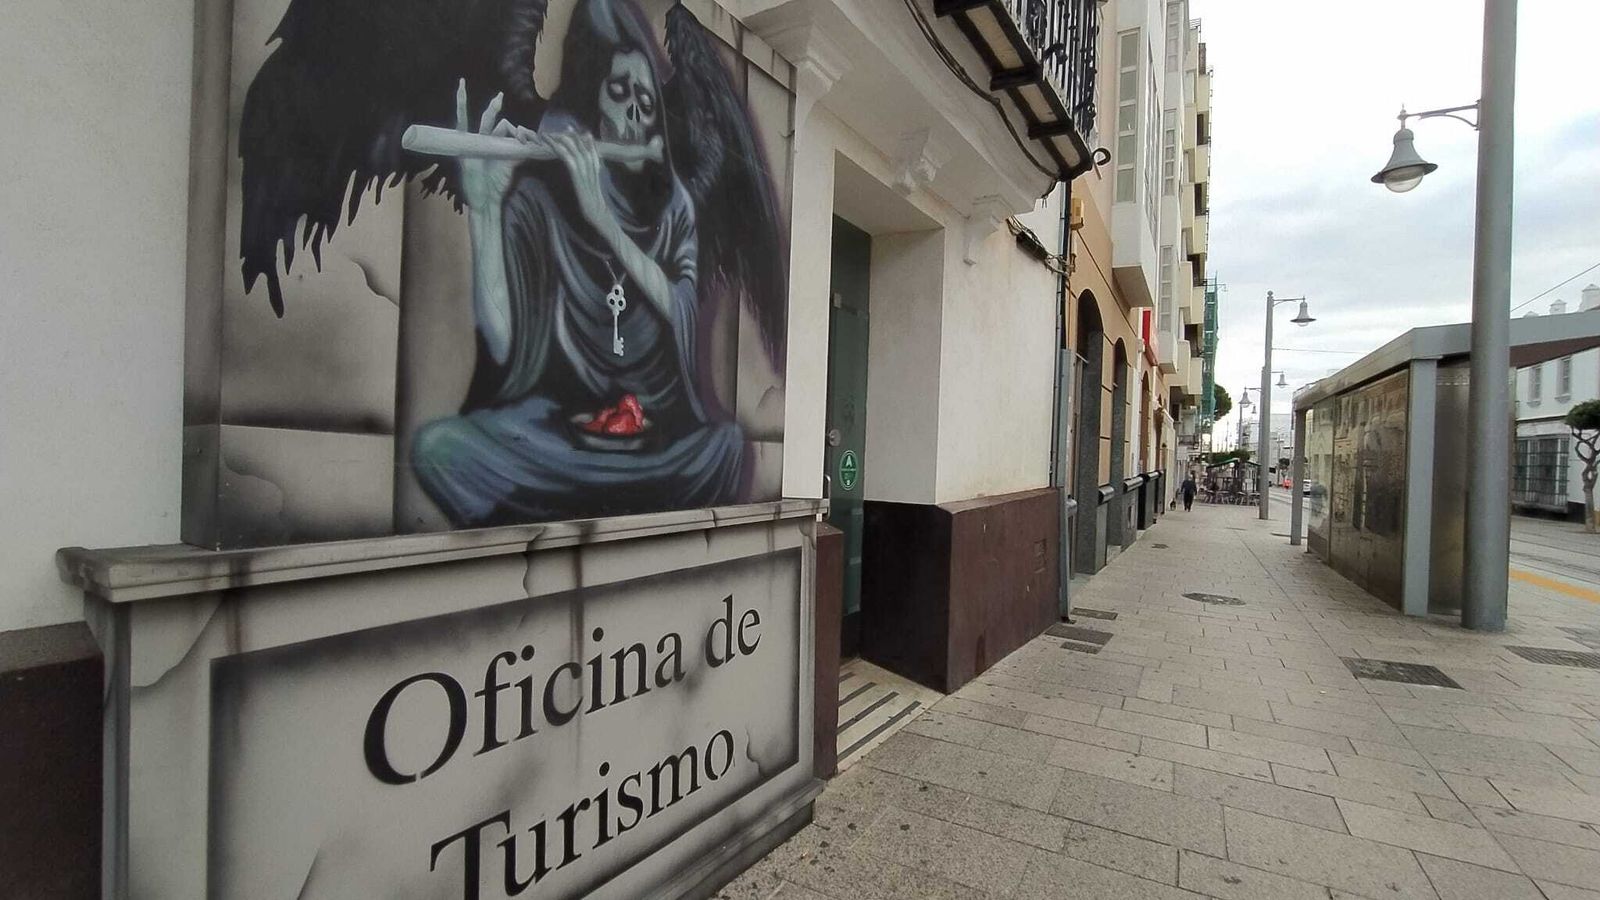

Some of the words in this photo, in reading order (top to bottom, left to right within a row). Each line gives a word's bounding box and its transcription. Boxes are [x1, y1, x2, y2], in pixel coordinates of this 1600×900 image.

[363, 626, 686, 786] Oficina
[704, 593, 762, 669] de
[430, 729, 735, 900] Turismo
